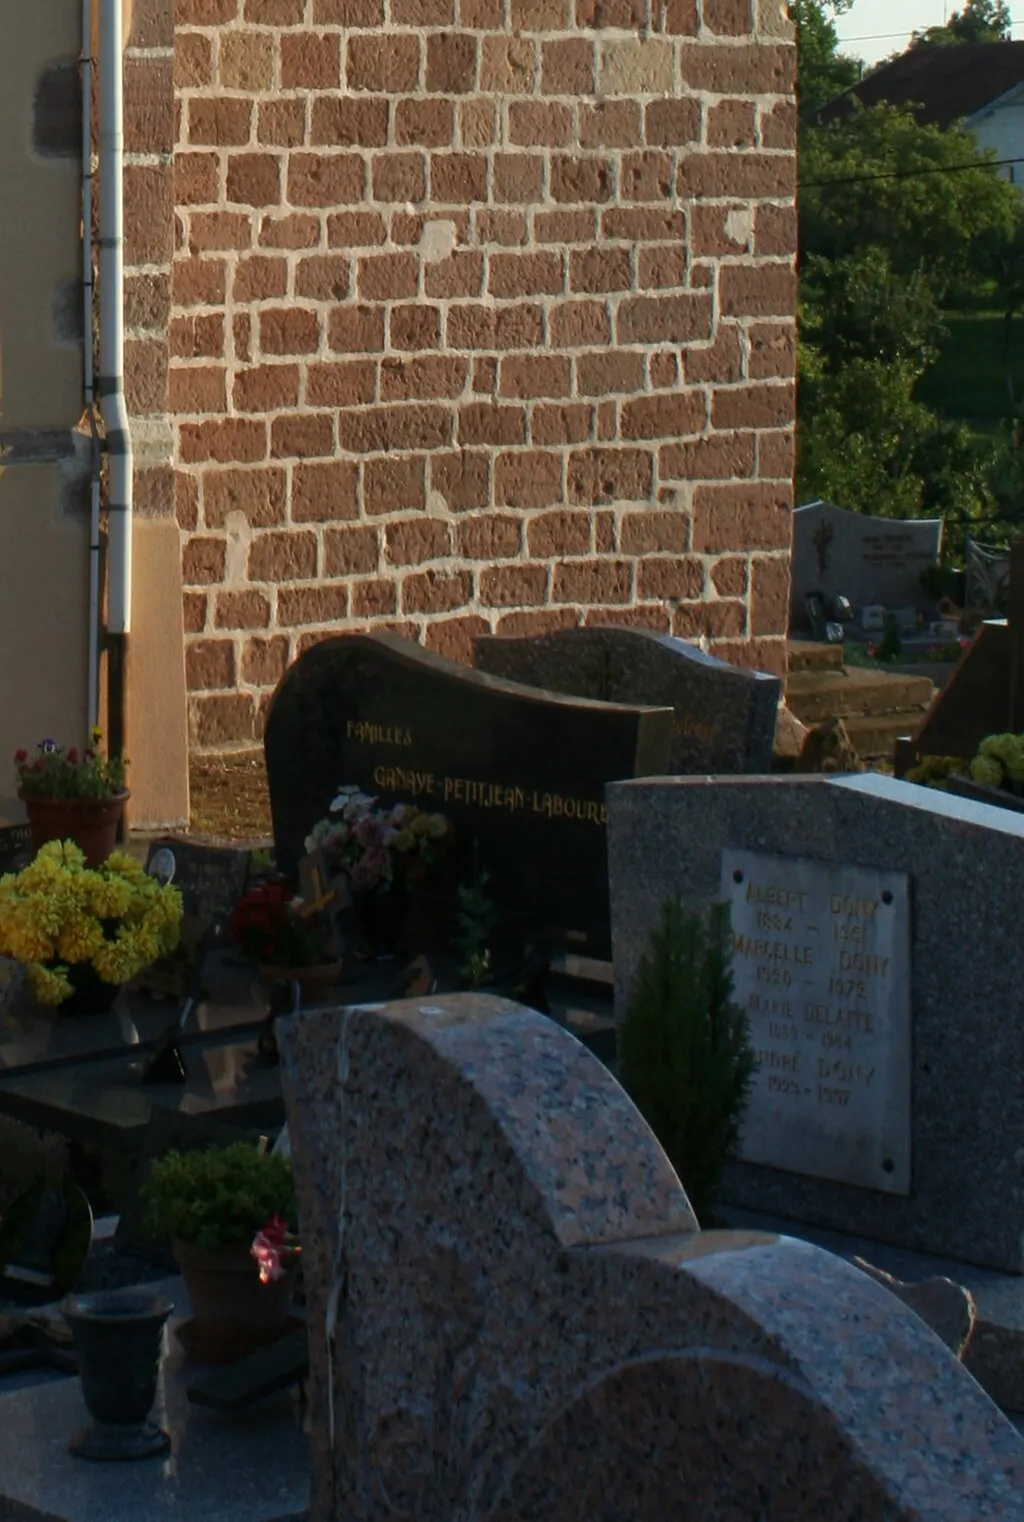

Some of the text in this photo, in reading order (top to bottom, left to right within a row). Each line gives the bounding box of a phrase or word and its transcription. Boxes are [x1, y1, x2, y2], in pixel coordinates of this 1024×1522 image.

[346, 720, 412, 747] FAMILLES
[746, 881, 878, 921] ALBERT DONY
[733, 932, 889, 978] MARCELLE DONY
[748, 993, 793, 1018] MARIE
[818, 1058, 875, 1086] DONY
